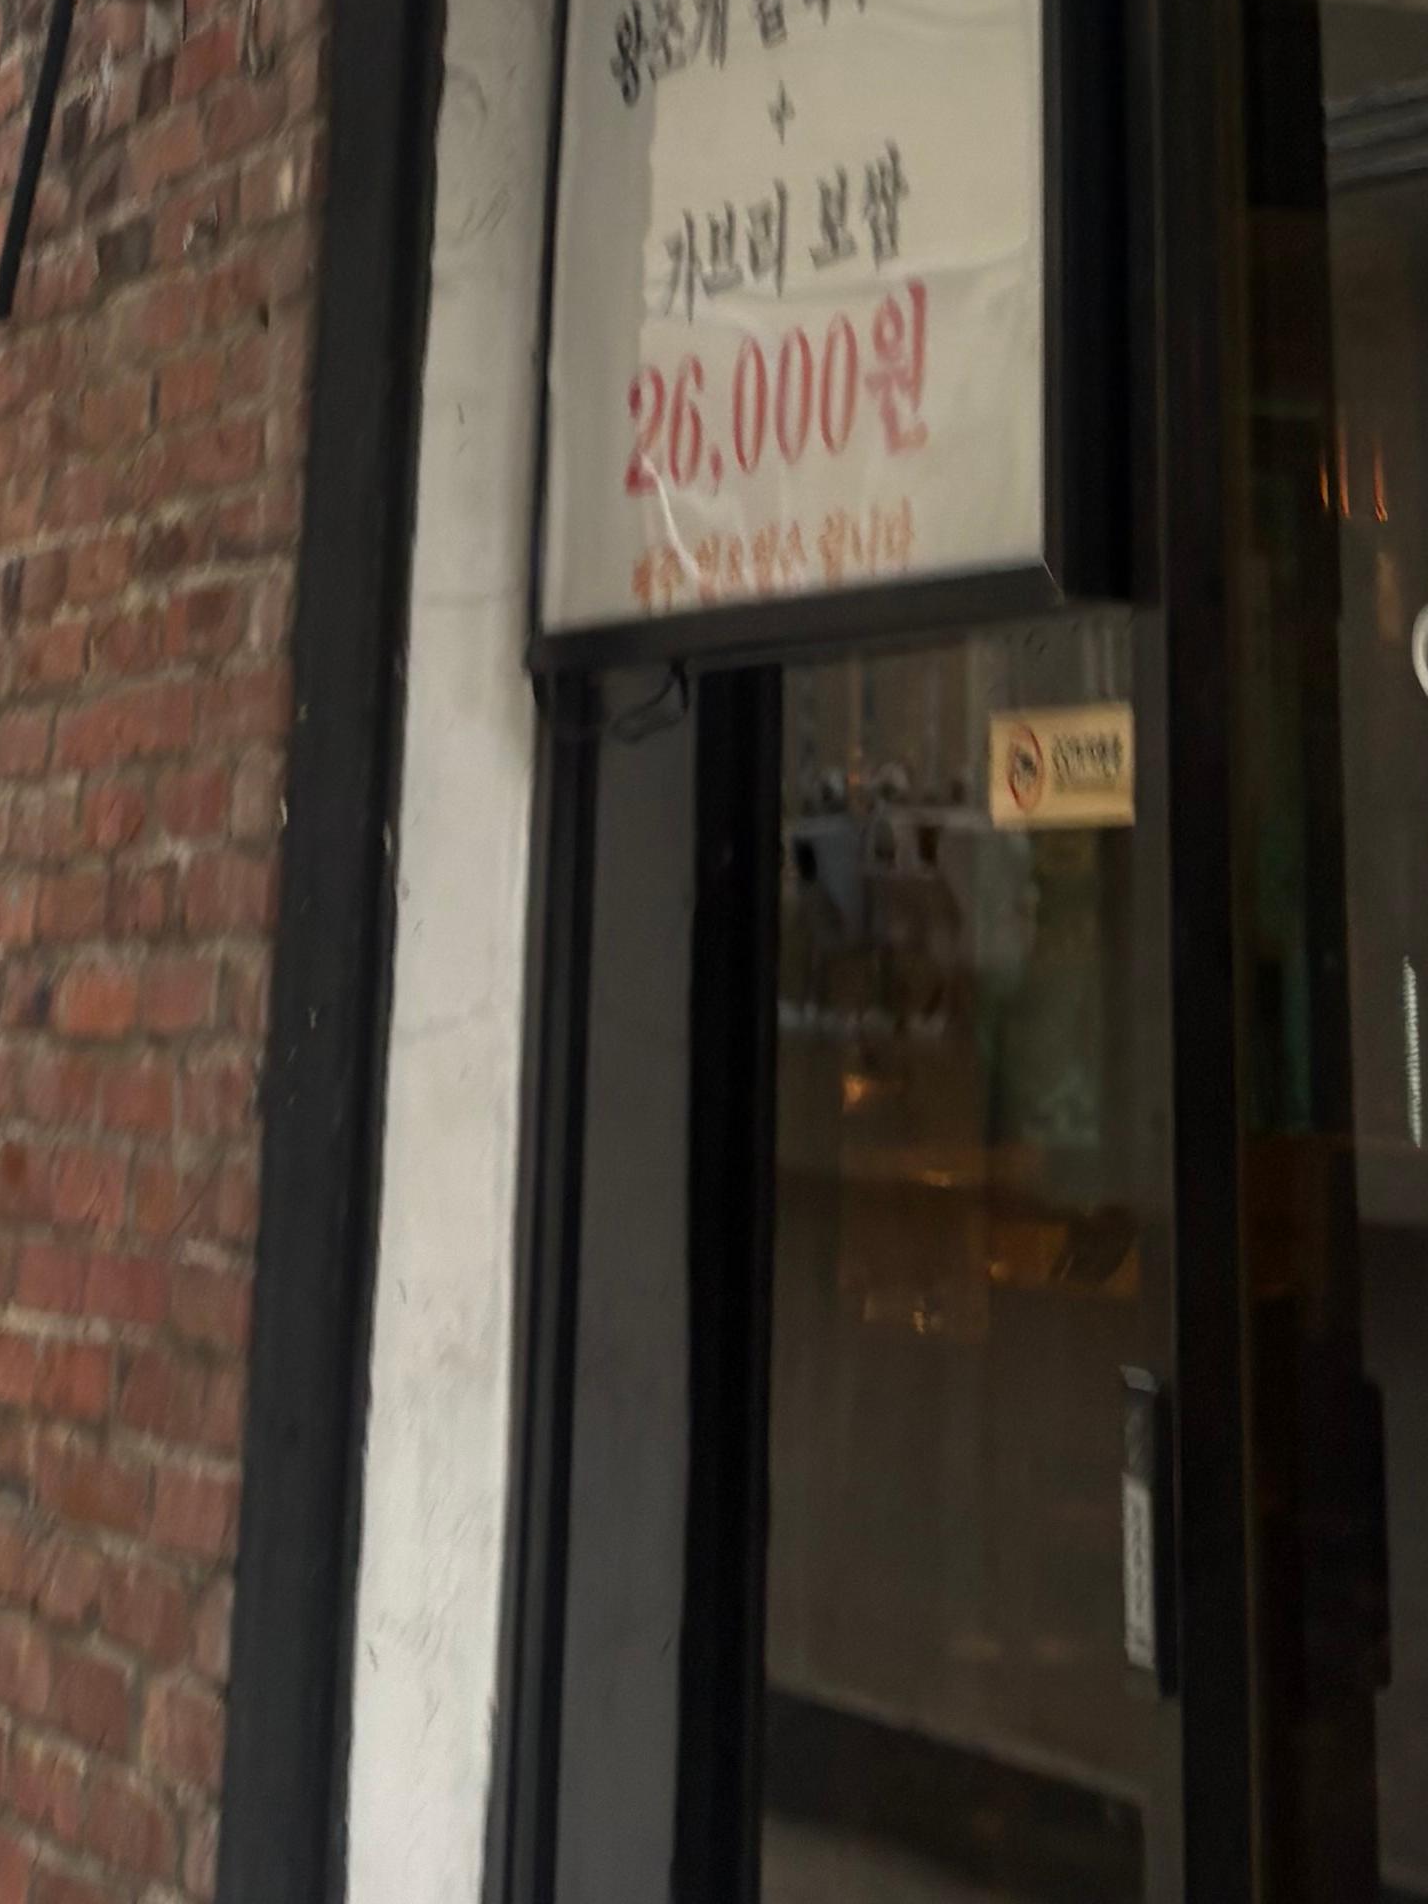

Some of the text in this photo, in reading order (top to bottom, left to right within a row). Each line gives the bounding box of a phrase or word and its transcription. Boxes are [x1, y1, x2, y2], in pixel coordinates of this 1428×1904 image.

[663, 138, 910, 325] 가브리 보쌈
[624, 276, 929, 498] 26,000원
